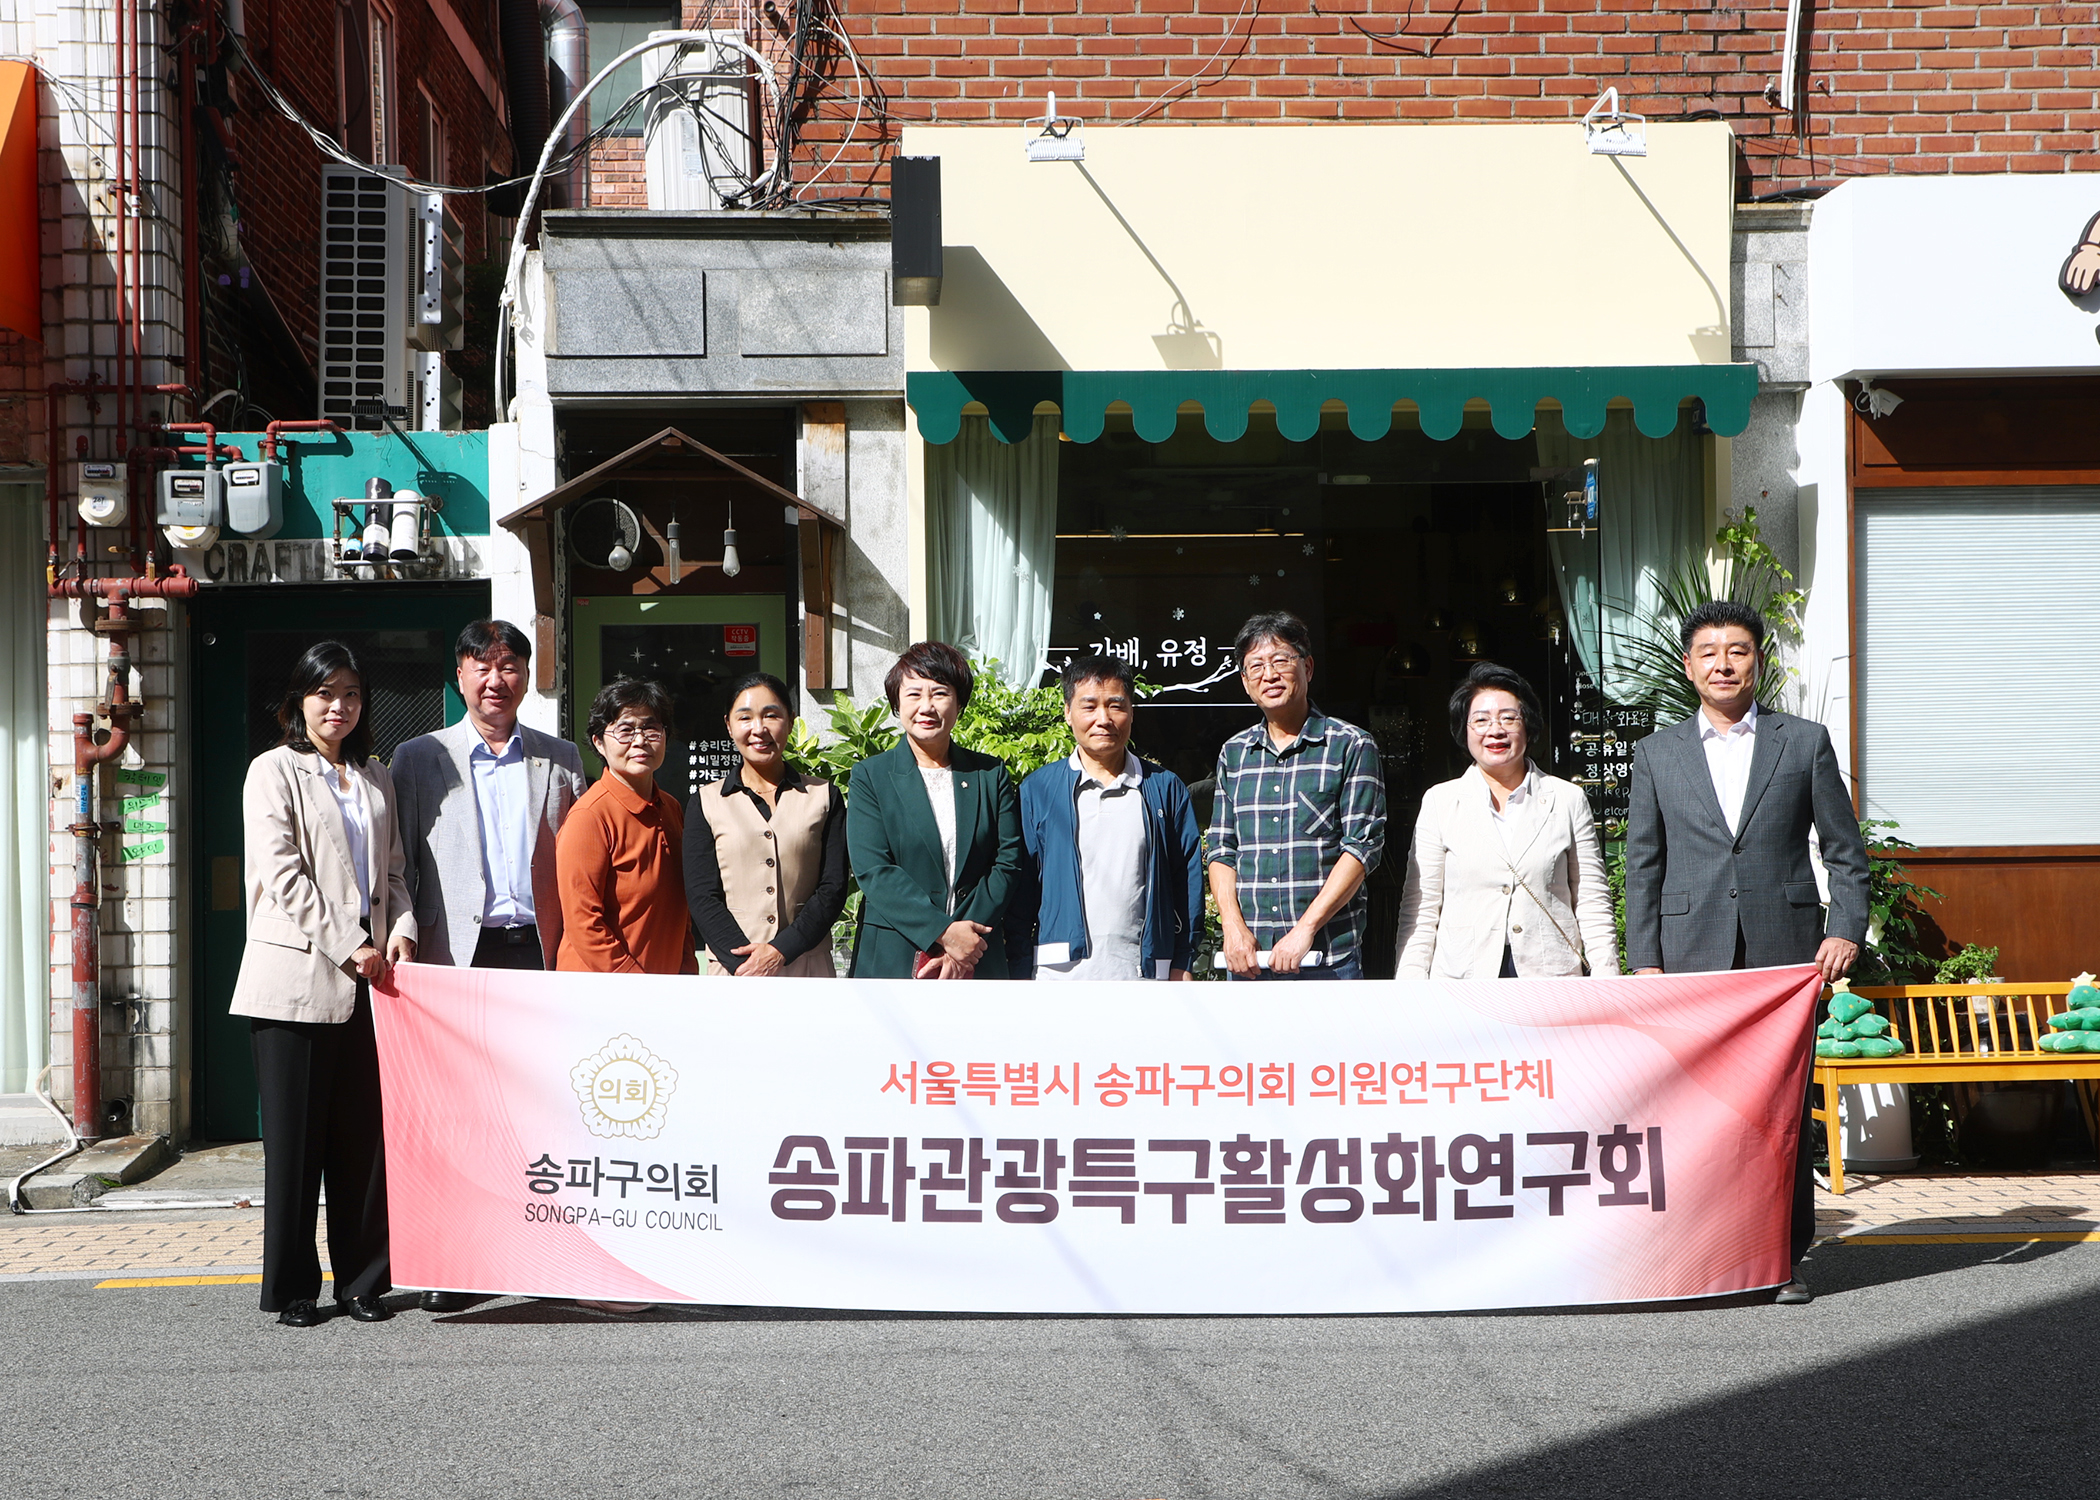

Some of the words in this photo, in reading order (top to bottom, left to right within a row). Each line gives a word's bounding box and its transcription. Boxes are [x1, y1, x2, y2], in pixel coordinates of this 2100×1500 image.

[1156, 636, 1207, 667] 유정
[689, 754, 741, 767] #비밀정원
[1585, 740, 1627, 757] 공휴일
[131, 843, 159, 858] 와인
[597, 1077, 649, 1106] 의회
[880, 1060, 1080, 1107] 서울특별시
[1093, 1062, 1295, 1108] 송파구의회
[1309, 1059, 1555, 1106] 의원연구단체
[525, 1153, 718, 1204] 송파구의회
[768, 1123, 1667, 1225] 송파관광특구활성화연구회
[525, 1203, 637, 1228] SONGPA-GU
[645, 1210, 723, 1231] COUNCIL
